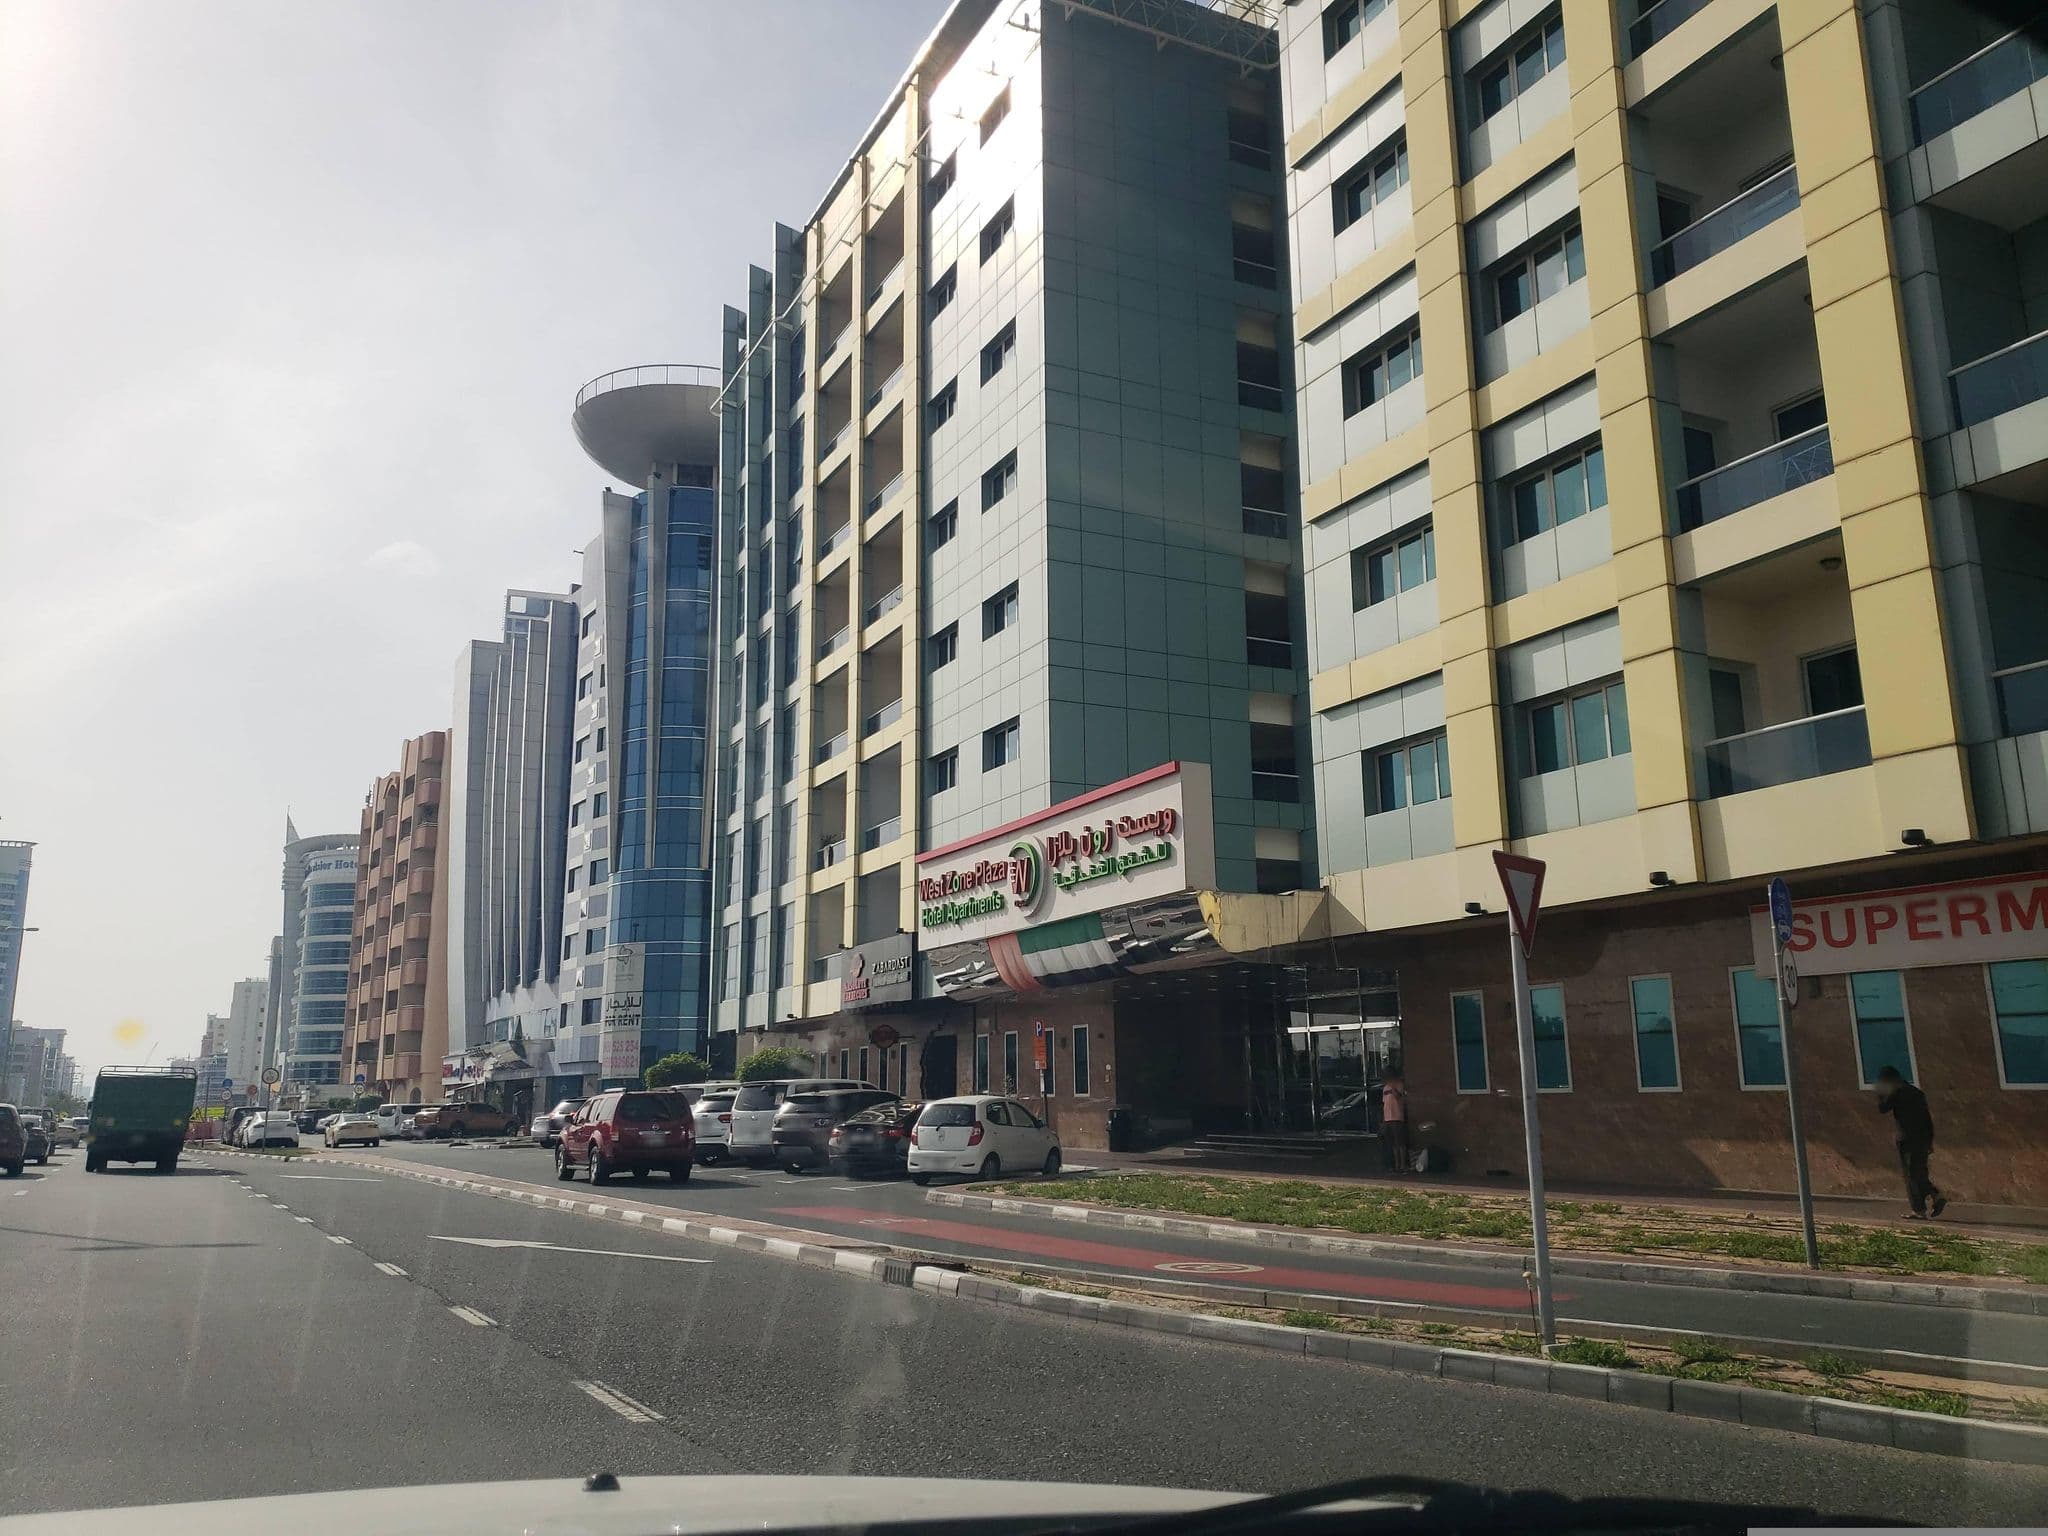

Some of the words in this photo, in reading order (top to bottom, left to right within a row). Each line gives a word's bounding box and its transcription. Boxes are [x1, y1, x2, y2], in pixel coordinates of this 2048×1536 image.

[1080, 819, 1113, 858] زون
[1116, 807, 1177, 838] ويست
[1046, 831, 1077, 867] بلازا
[1116, 841, 1173, 877] للشقق
[920, 876, 944, 901] West
[945, 869, 976, 895] Zone
[974, 860, 1008, 887] Plaza
[1053, 856, 1116, 890] الفندقية
[922, 903, 945, 928] Hotel
[946, 890, 1005, 923] Apartments
[604, 1014, 616, 1028] FOR
[617, 1013, 641, 1027] RENT
